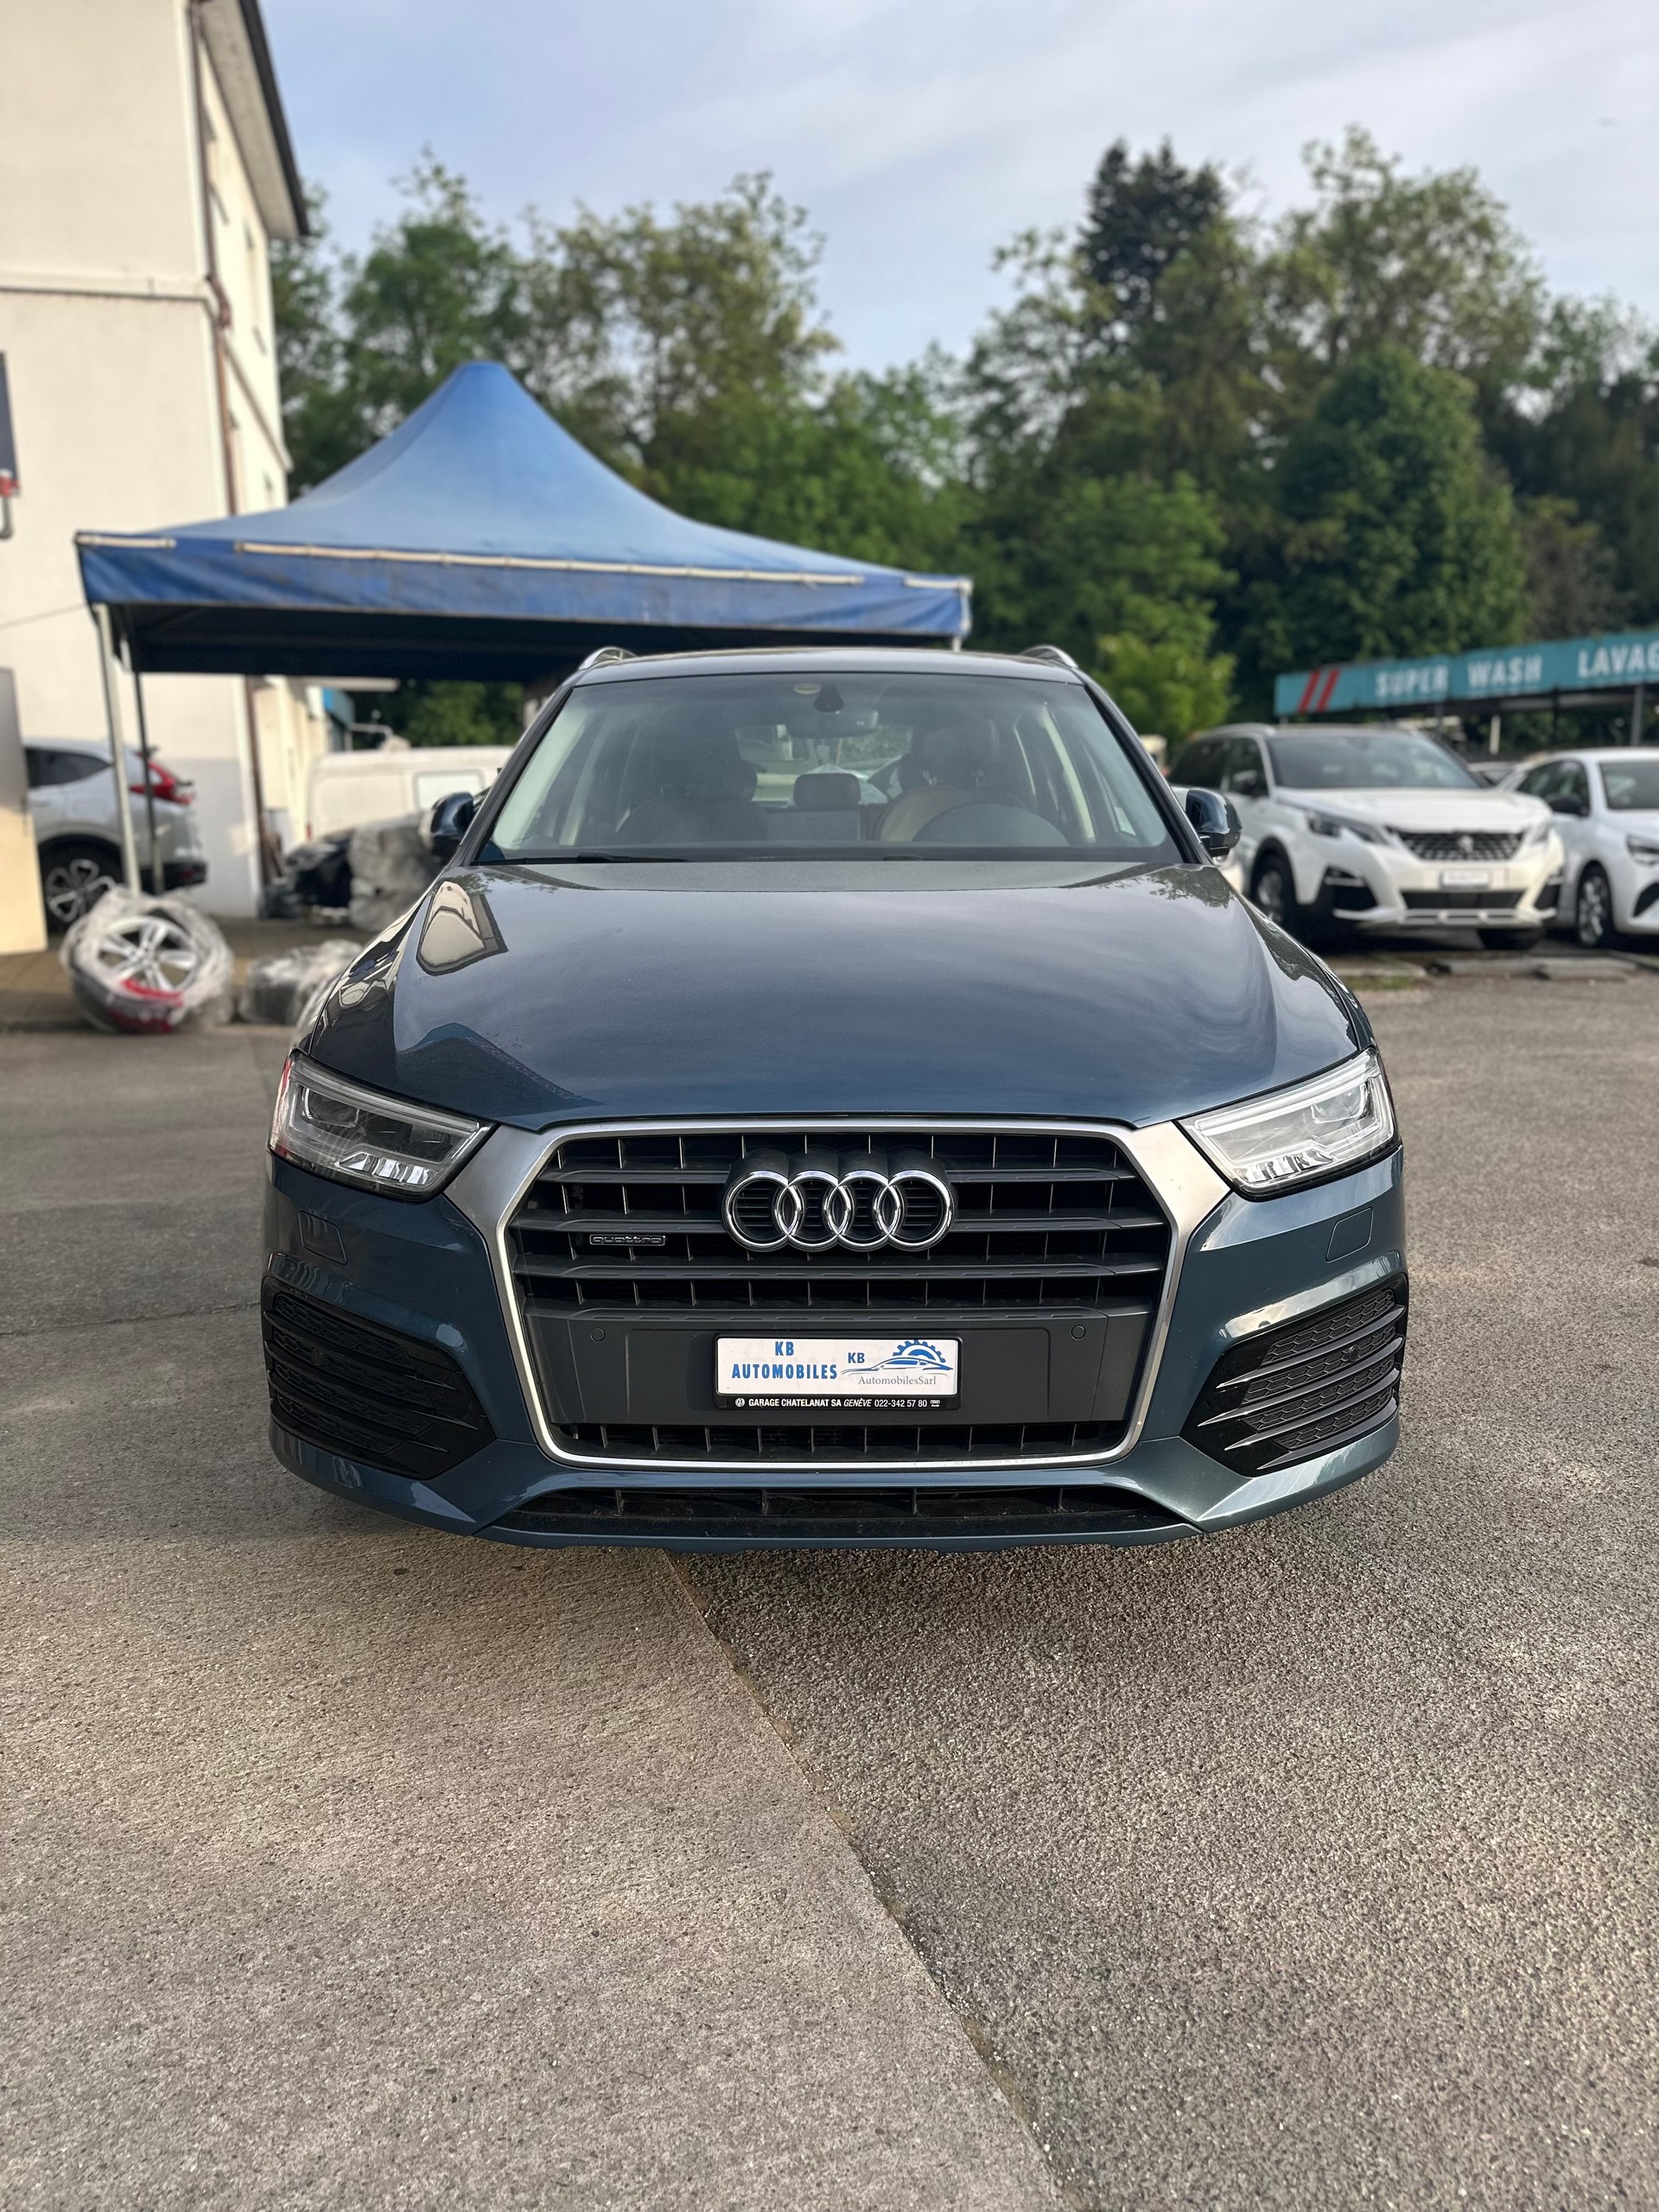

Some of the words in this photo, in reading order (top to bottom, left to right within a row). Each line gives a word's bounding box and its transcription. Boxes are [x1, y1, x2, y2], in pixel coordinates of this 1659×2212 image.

[1376, 664, 1449, 697] SUPER
[1467, 655, 1542, 689] WASH
[1577, 640, 1659, 678] LAVAG
[593, 1236, 662, 1244] quattro
[774, 1341, 794, 1357] KB
[848, 1351, 865, 1363] KB
[731, 1363, 837, 1380] AUTOMOBILES
[748, 1398, 779, 1407] GARAGE
[781, 1398, 831, 1408] CHATELANAT
[831, 1398, 842, 1407] SA
[843, 1397, 873, 1408] GENÈVE
[874, 1399, 906, 1408] 022-342
[907, 1399, 917, 1408] 57
[918, 1399, 928, 1408] 80
